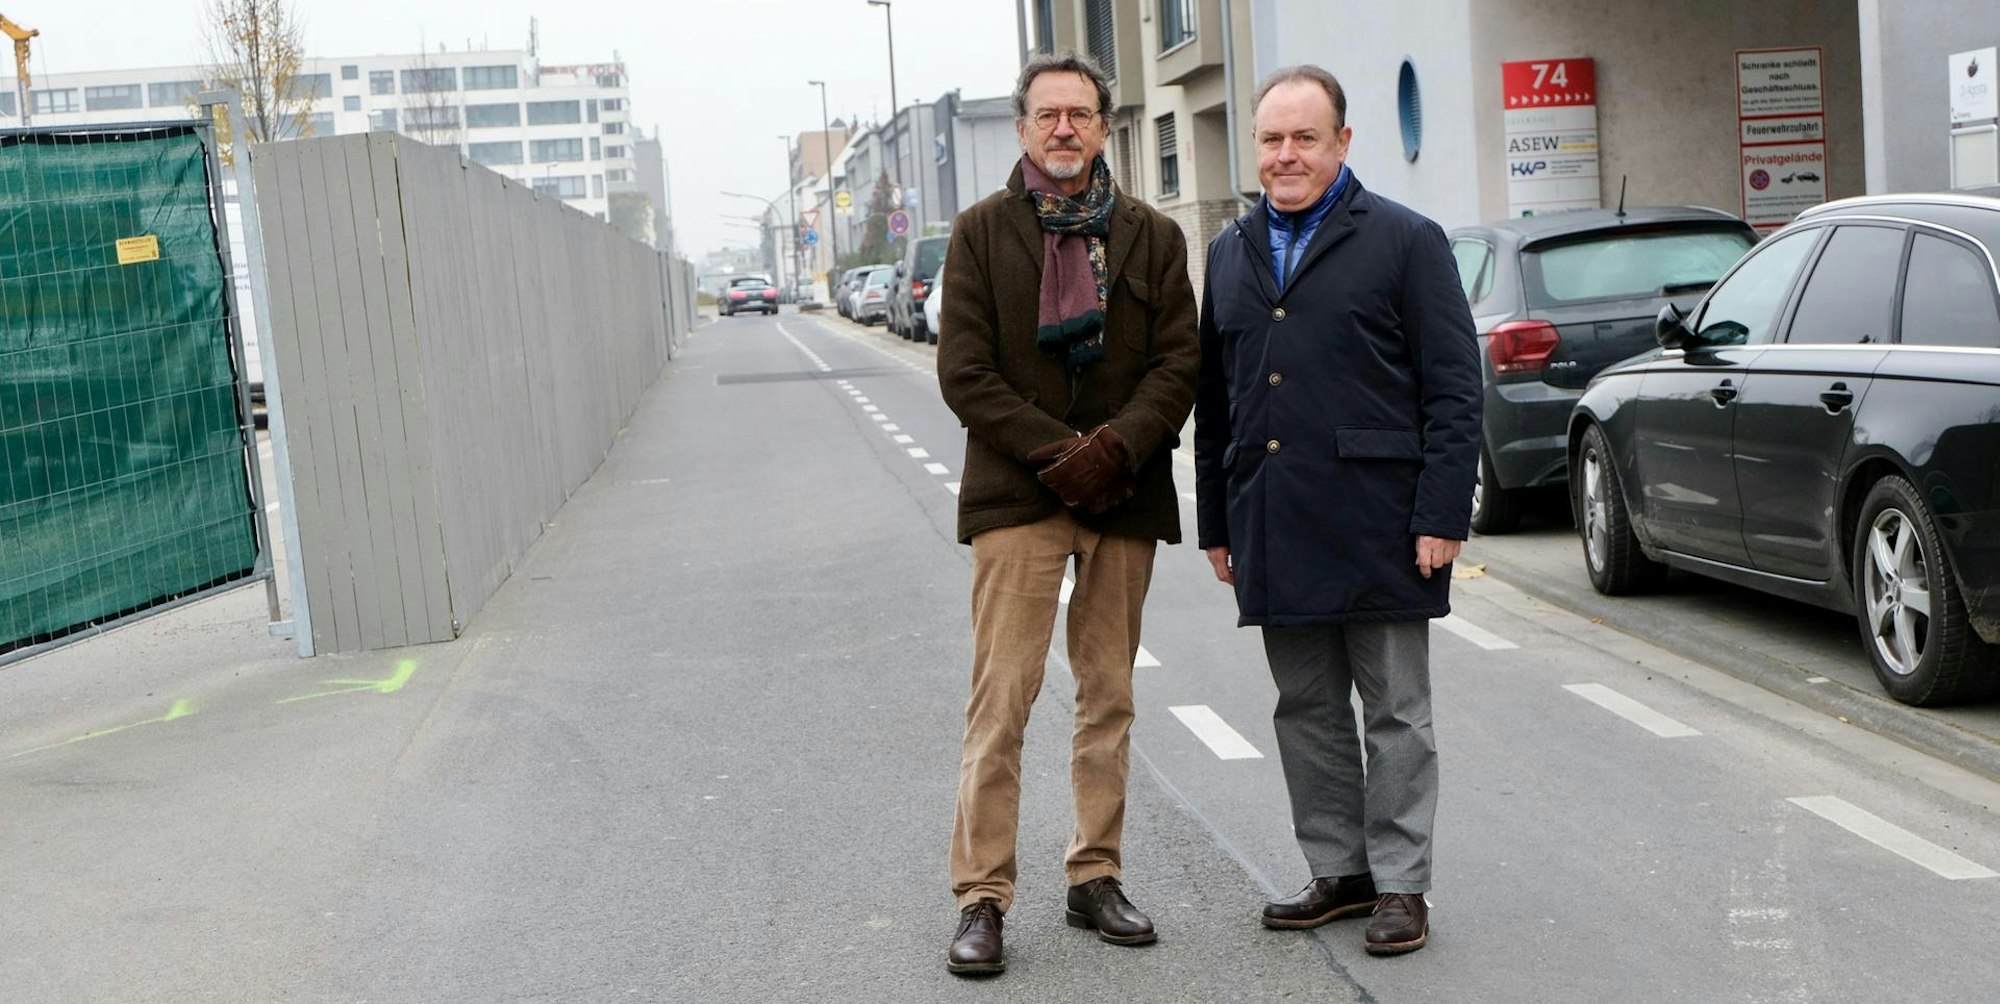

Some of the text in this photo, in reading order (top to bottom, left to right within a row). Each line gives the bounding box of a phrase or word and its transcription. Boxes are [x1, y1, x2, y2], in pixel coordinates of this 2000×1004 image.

[1741, 58, 1817, 71] Schranke schließt
[1531, 62, 1569, 90] 74
[1769, 72, 1790, 81] nach
[1746, 121, 1819, 136] Feuerwehrzufahrt
[1508, 135, 1559, 152] ASEW
[1744, 151, 1822, 167] Privatgelände
[1550, 360, 1577, 370] POLO
